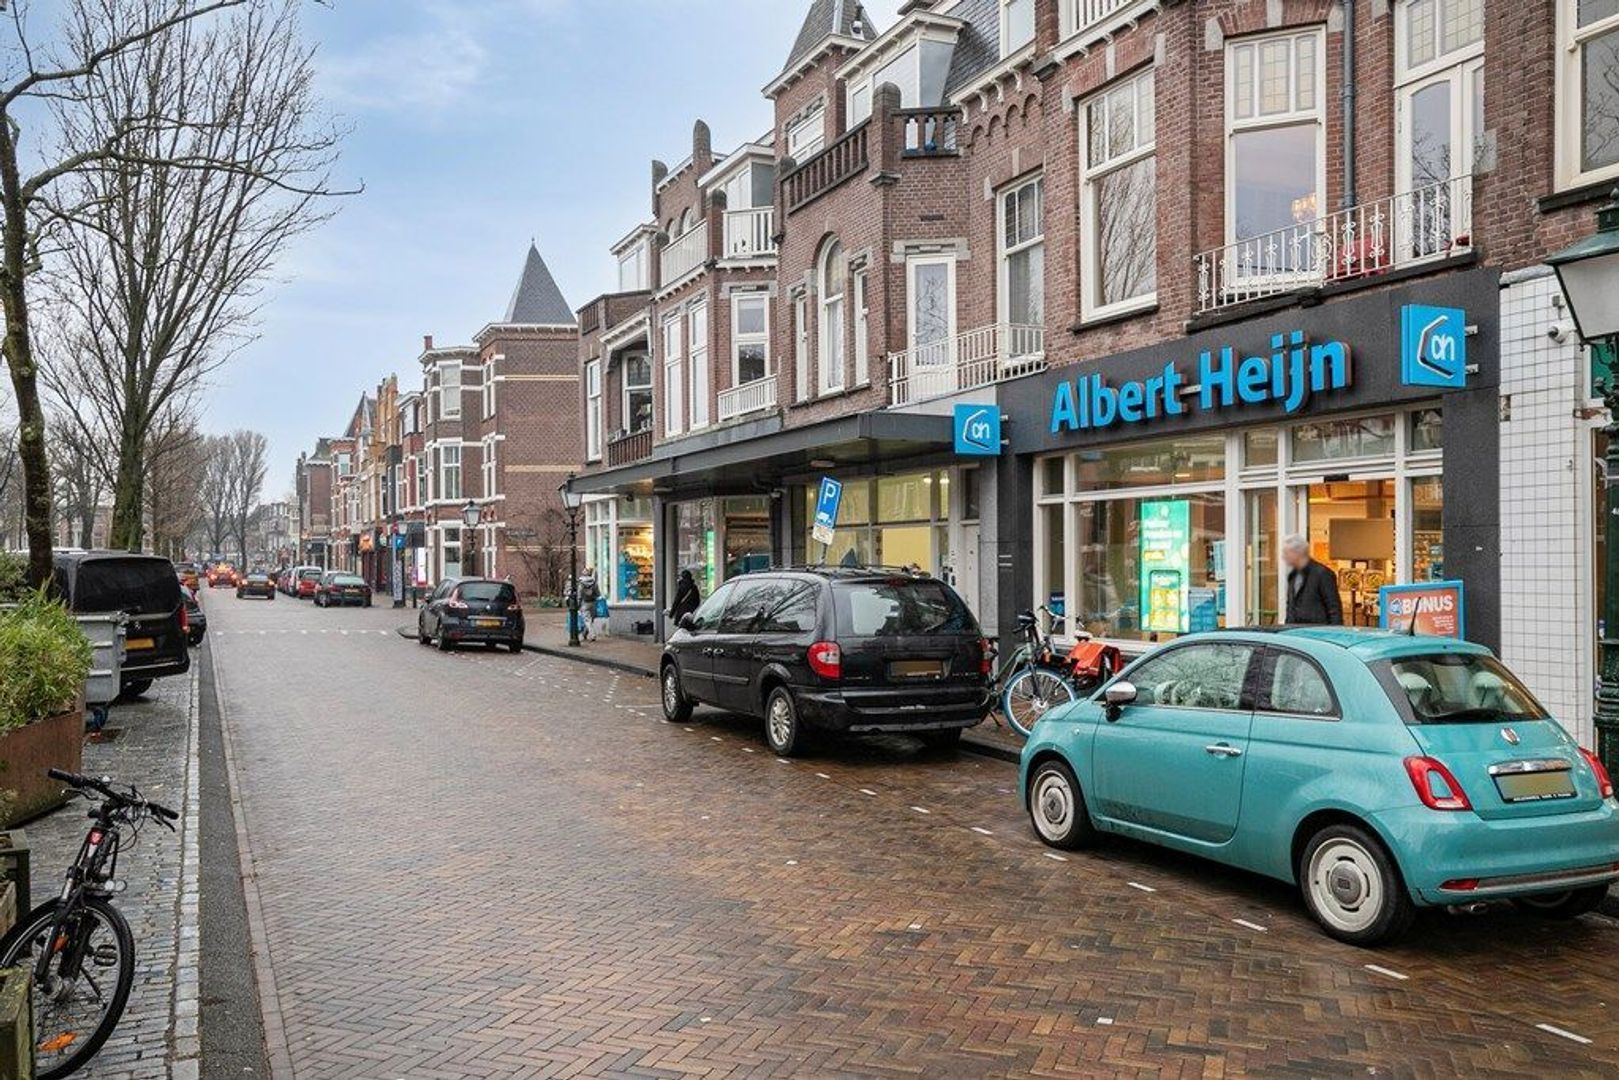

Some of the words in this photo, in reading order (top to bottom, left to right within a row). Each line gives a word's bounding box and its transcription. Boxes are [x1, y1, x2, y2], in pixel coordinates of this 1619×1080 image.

[1051, 361, 1184, 434] Albert
[1199, 331, 1350, 413] Heijn
[822, 483, 837, 505] P
[1402, 594, 1454, 614] BONUS
